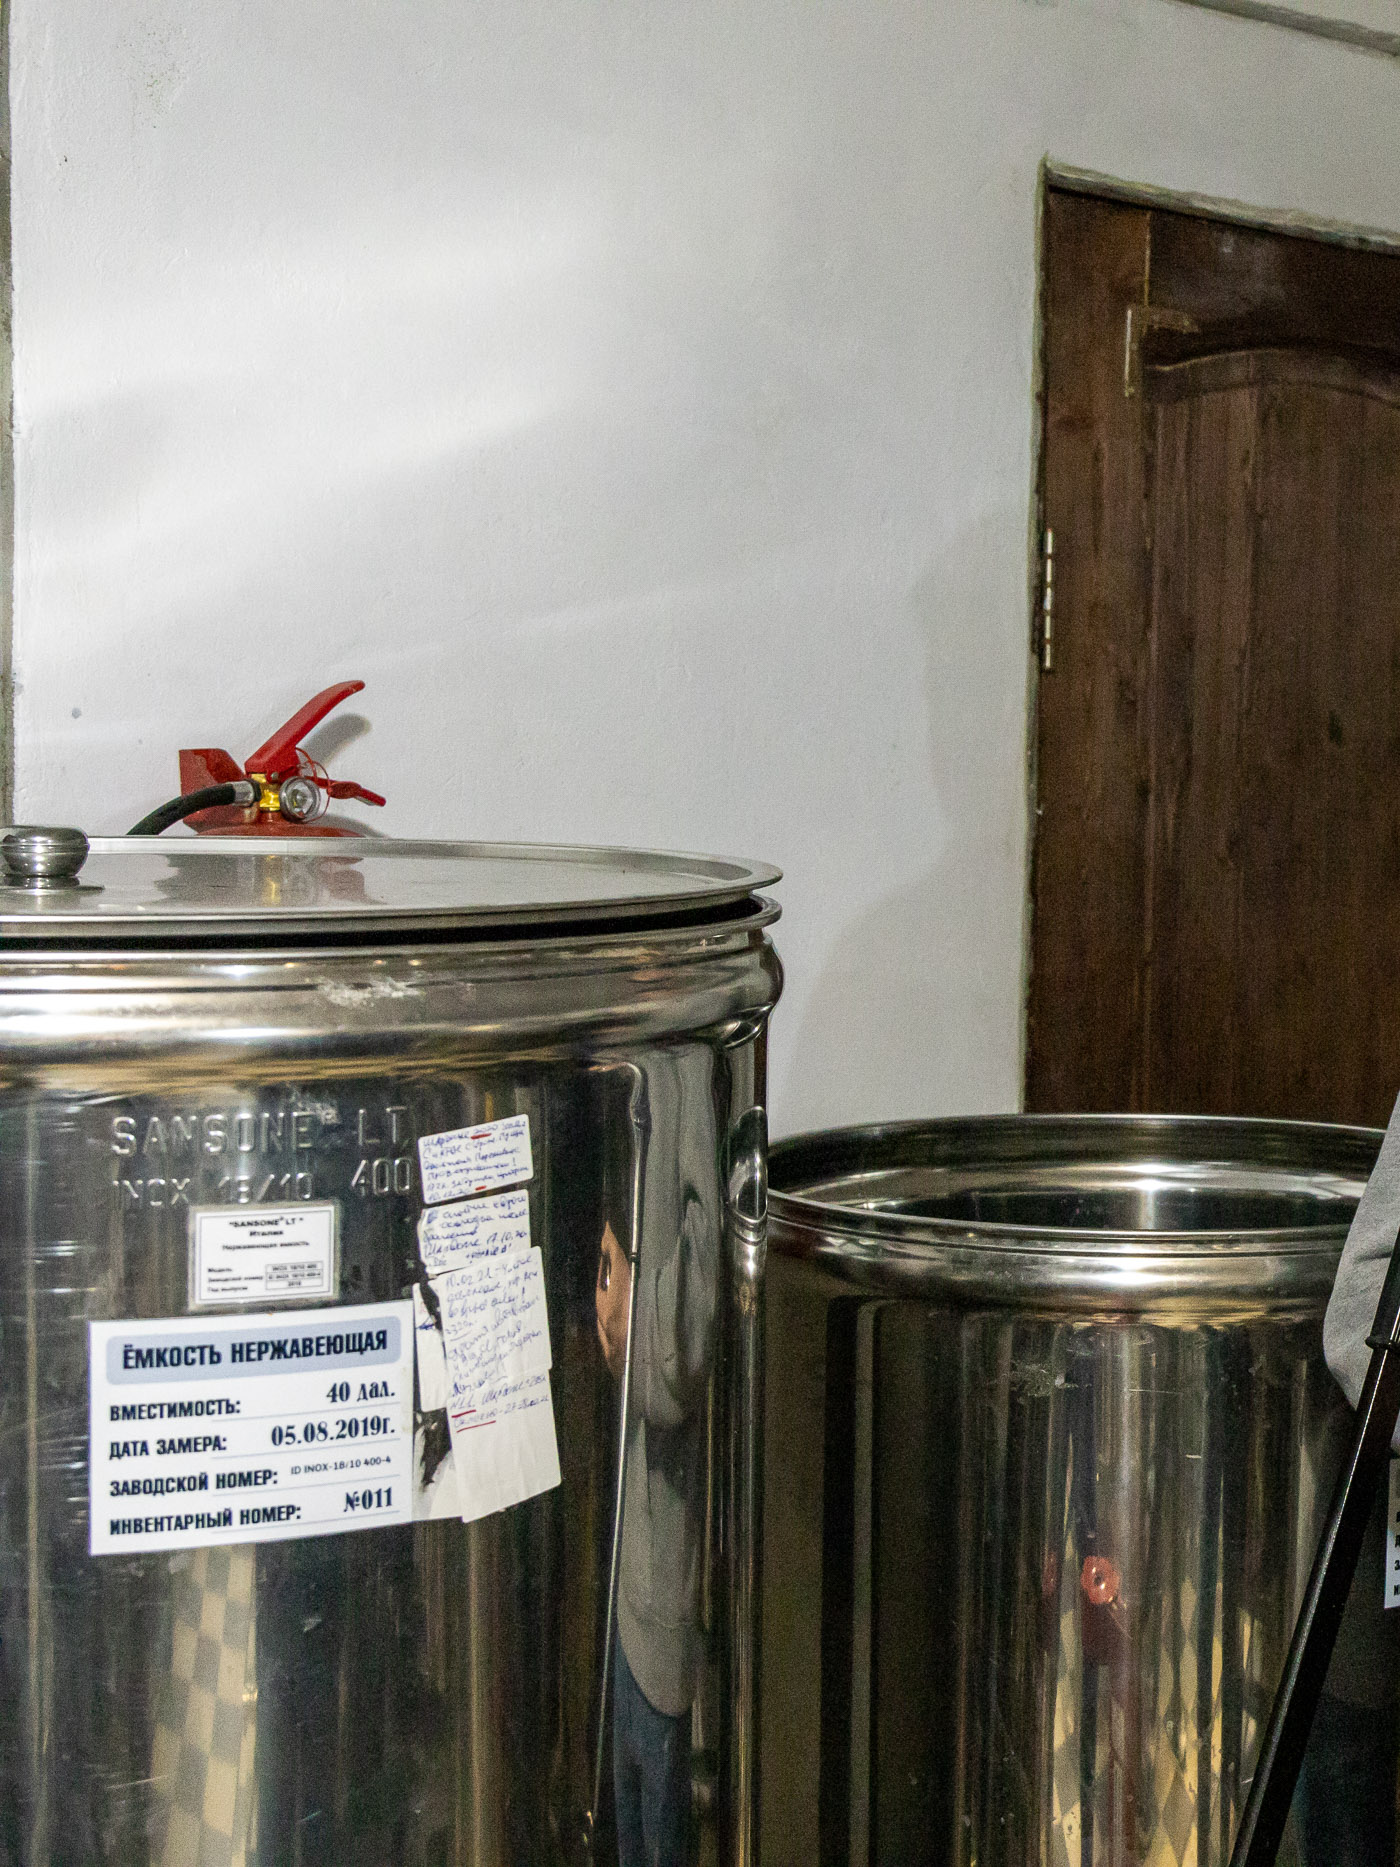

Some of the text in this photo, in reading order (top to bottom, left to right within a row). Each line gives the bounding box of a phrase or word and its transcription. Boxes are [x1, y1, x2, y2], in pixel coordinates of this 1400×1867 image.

[111, 1111, 314, 1155] SANSONE
[357, 1105, 407, 1147] LT
[350, 1157, 411, 1197] 400
[123, 1329, 388, 1369] ЁМКОСТЬ НЕРЖАВЕЮЩАЯ
[110, 1398, 241, 1421] ВМЕСТИМОСТЬ:
[326, 1381, 351, 1403] 40
[109, 1415, 396, 1460] ДАТА ЗАМЕРА: 05.08.2019г.
[110, 1455, 392, 1497] ЗАВОДСКОЙ НОМЕР: ID INOX-18/10 400-4
[110, 1486, 392, 1535] ИНВЕНТАРНЫЙ НОМЕР: №011
